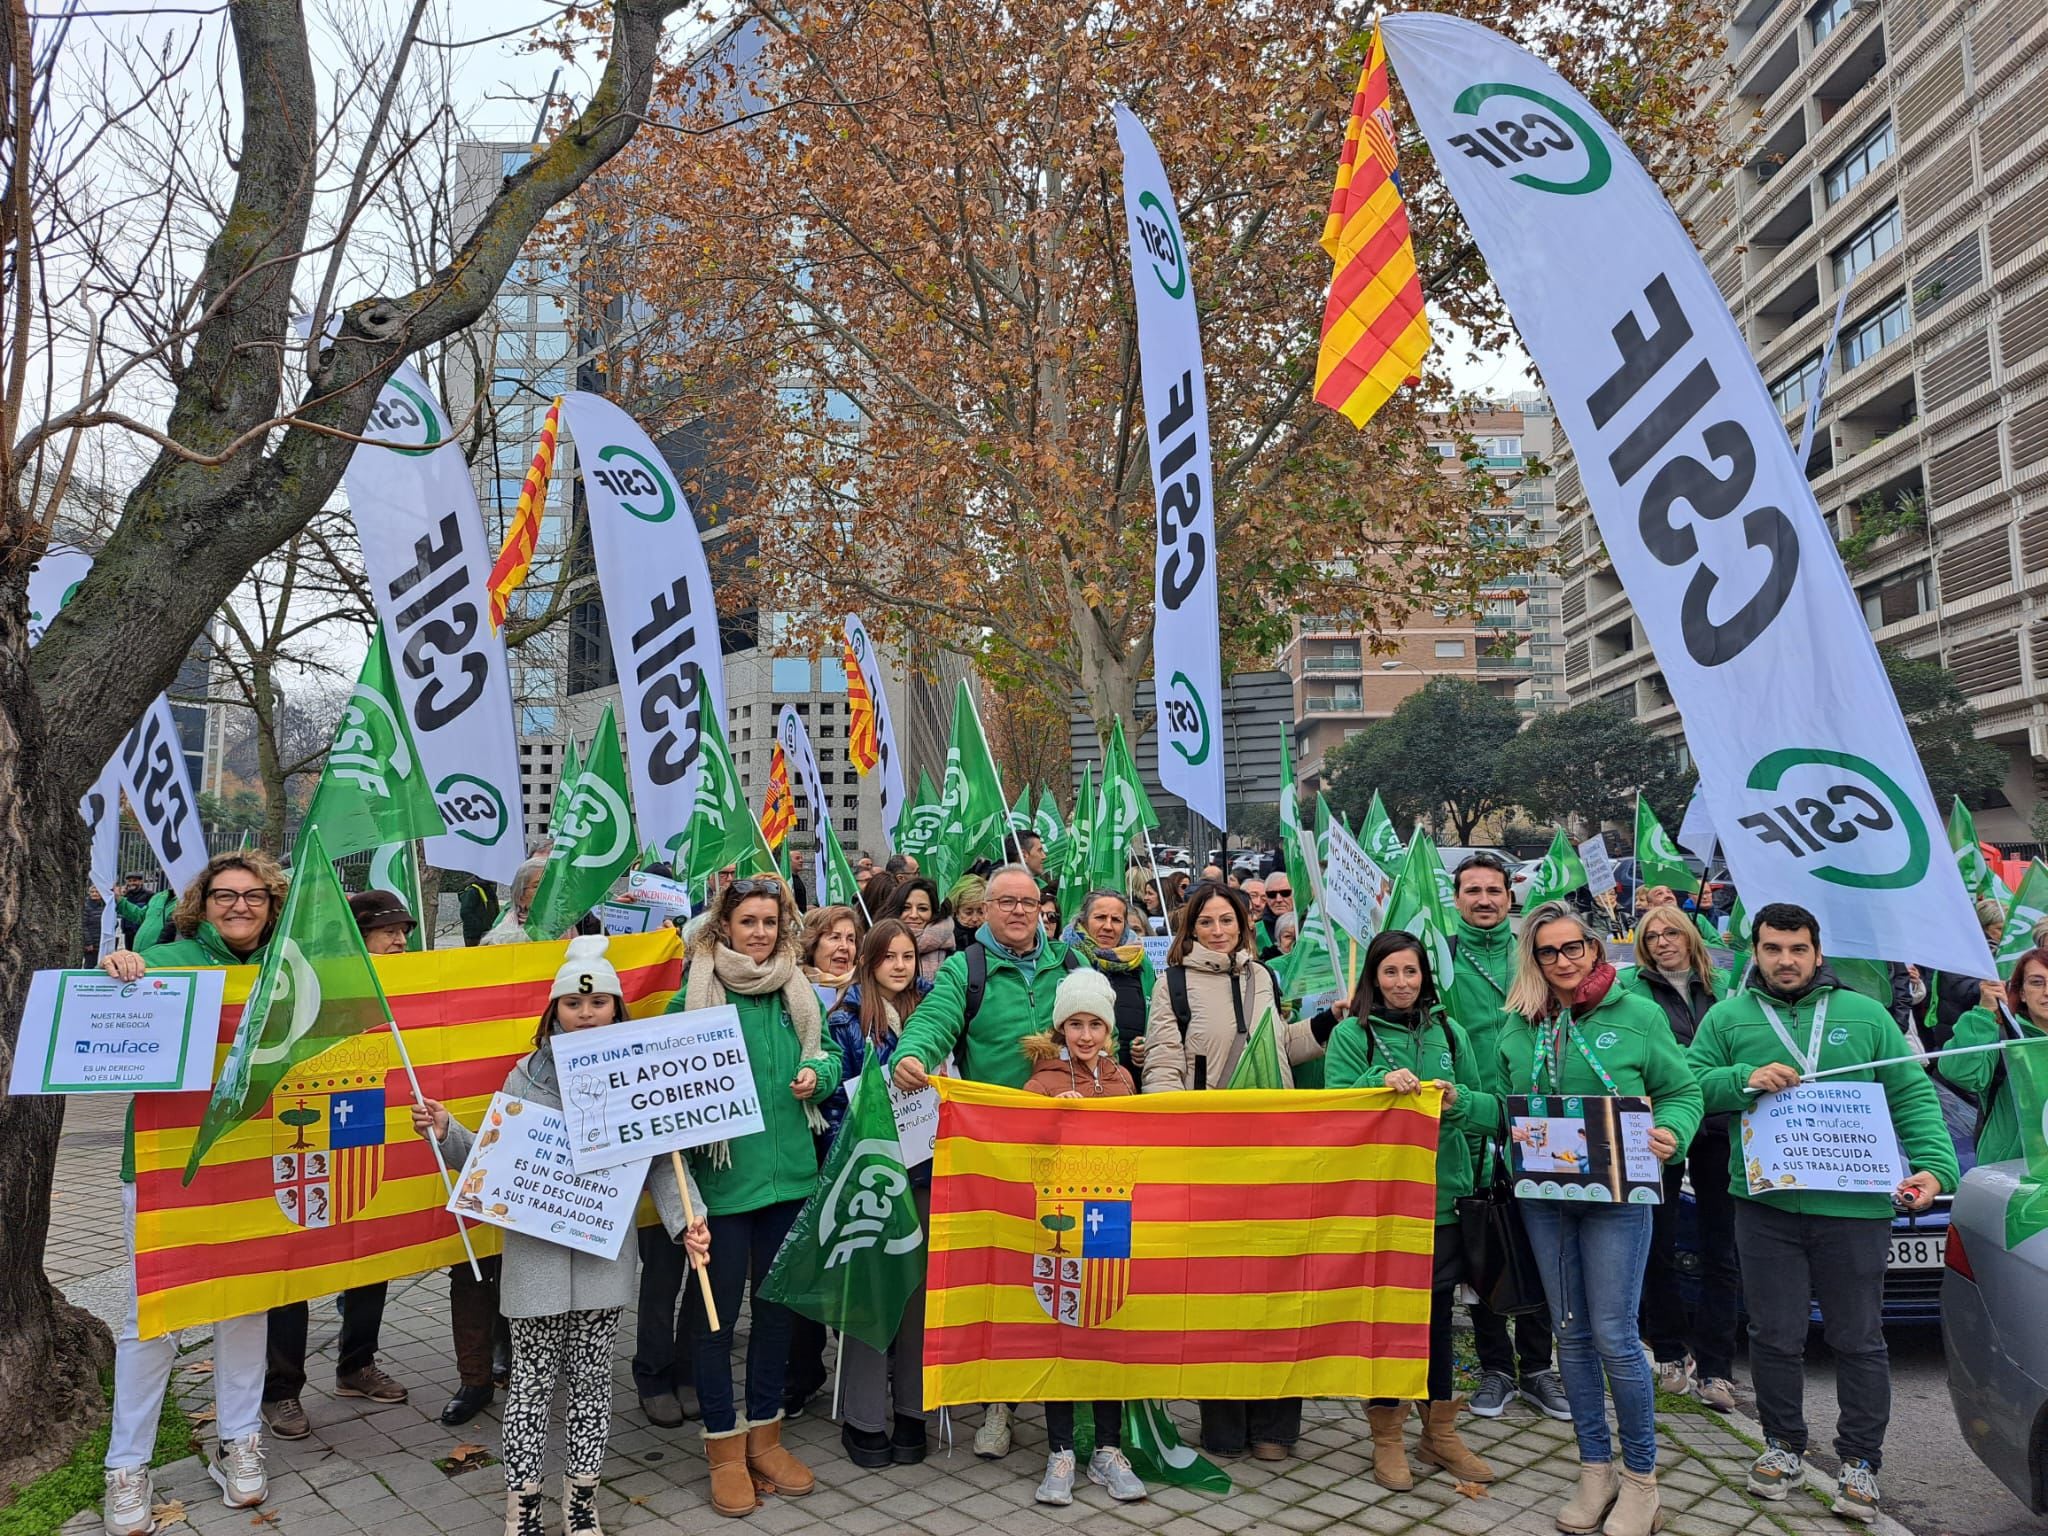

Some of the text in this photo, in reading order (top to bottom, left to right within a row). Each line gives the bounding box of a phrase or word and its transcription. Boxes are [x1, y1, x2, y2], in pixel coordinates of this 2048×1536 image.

[578, 974, 593, 994] S
[90, 1012, 126, 1020] NUESTRA
[115, 1021, 151, 1029] NEGOCIA
[92, 1039, 160, 1054] muface
[602, 1047, 631, 1062] UNA
[645, 1034, 695, 1054] muface
[108, 1064, 145, 1072] DERECHO
[609, 1048, 745, 1089] EL APOYO DEL
[122, 1073, 143, 1081] LUJO
[631, 1075, 735, 1110] GOBIERNO
[1775, 1089, 1861, 1103] UN GOBIERNO
[893, 1100, 922, 1119] GIMOS
[1769, 1103, 1872, 1118] QUE NO INVIERTE
[543, 1116, 561, 1129] UN
[618, 1097, 758, 1143] ES ESENCIAL!
[1786, 1118, 1864, 1130] EN muface,
[527, 1128, 554, 1144] QUE
[1775, 1132, 1877, 1144] ES UN GOBIERNO
[535, 1148, 552, 1161] EN
[1783, 1147, 1872, 1159] QUE DESCUIDA
[1772, 1161, 1890, 1173] A SUS TRABAJADORES
[514, 1158, 619, 1198] ES UN GOBIERNO
[513, 1176, 604, 1212] QUE DESCUIDA
[491, 1187, 615, 1232] A SUS TRABAJADORES
